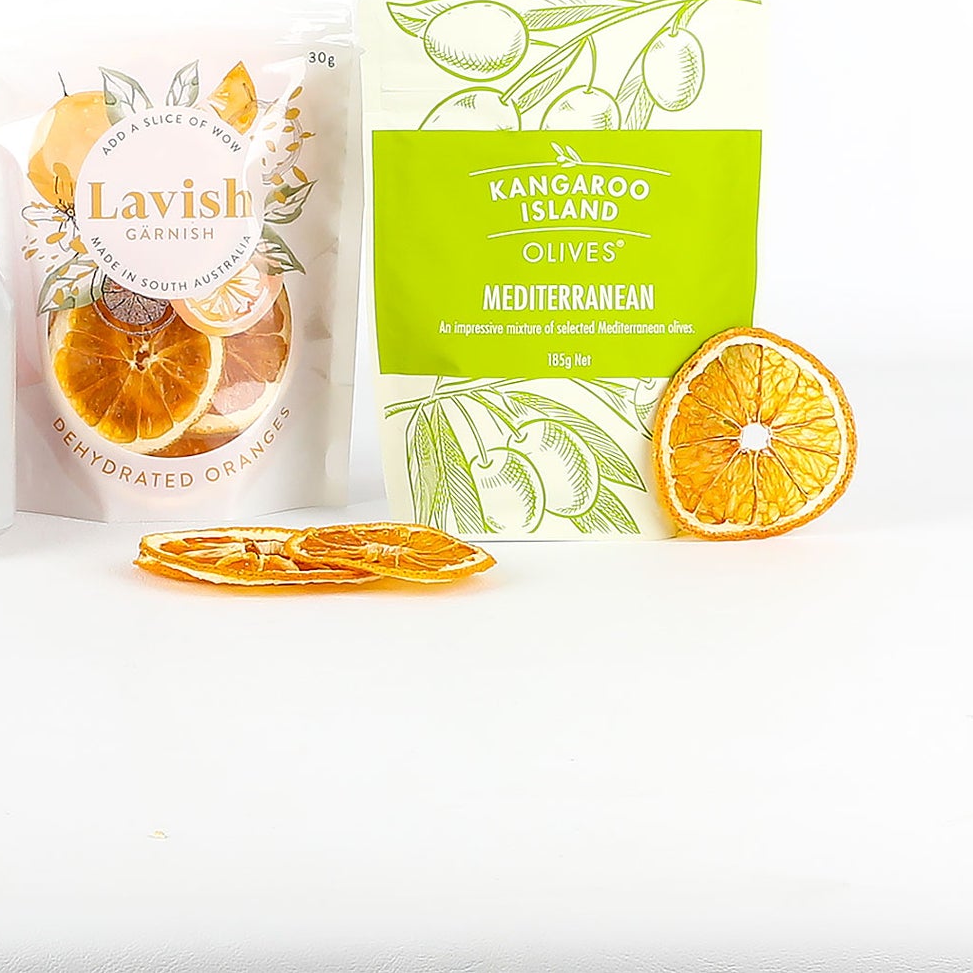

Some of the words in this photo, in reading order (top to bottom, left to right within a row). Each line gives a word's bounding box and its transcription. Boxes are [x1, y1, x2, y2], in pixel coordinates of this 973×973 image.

[308, 51, 336, 68] 30g
[100, 130, 127, 156] ADD
[130, 124, 140, 134] A
[143, 113, 183, 128] SLICE
[188, 116, 209, 128] OF
[211, 126, 243, 154] WOW
[87, 178, 254, 221] Lavish
[488, 173, 651, 203] KANGAROO
[520, 200, 619, 223] ISLAND
[125, 224, 215, 241] GÄRNISH
[89, 235, 121, 273] MADE
[121, 267, 136, 284] IN
[139, 277, 188, 292] SOUTH
[193, 233, 251, 289] AUSTRALIA
[481, 284, 655, 312] MEDITERRANEAN
[438, 321, 452, 334] An
[454, 320, 504, 336] impressive
[506, 321, 542, 335] mixture
[544, 320, 554, 334] of
[556, 320, 596, 335] selected
[597, 320, 666, 335] Mediterranean
[667, 320, 696, 335] olives.
[547, 353, 572, 370] 185g
[574, 352, 592, 367] Net
[52, 416, 194, 488] DEHYDRATED
[204, 405, 291, 482] ORANGES
